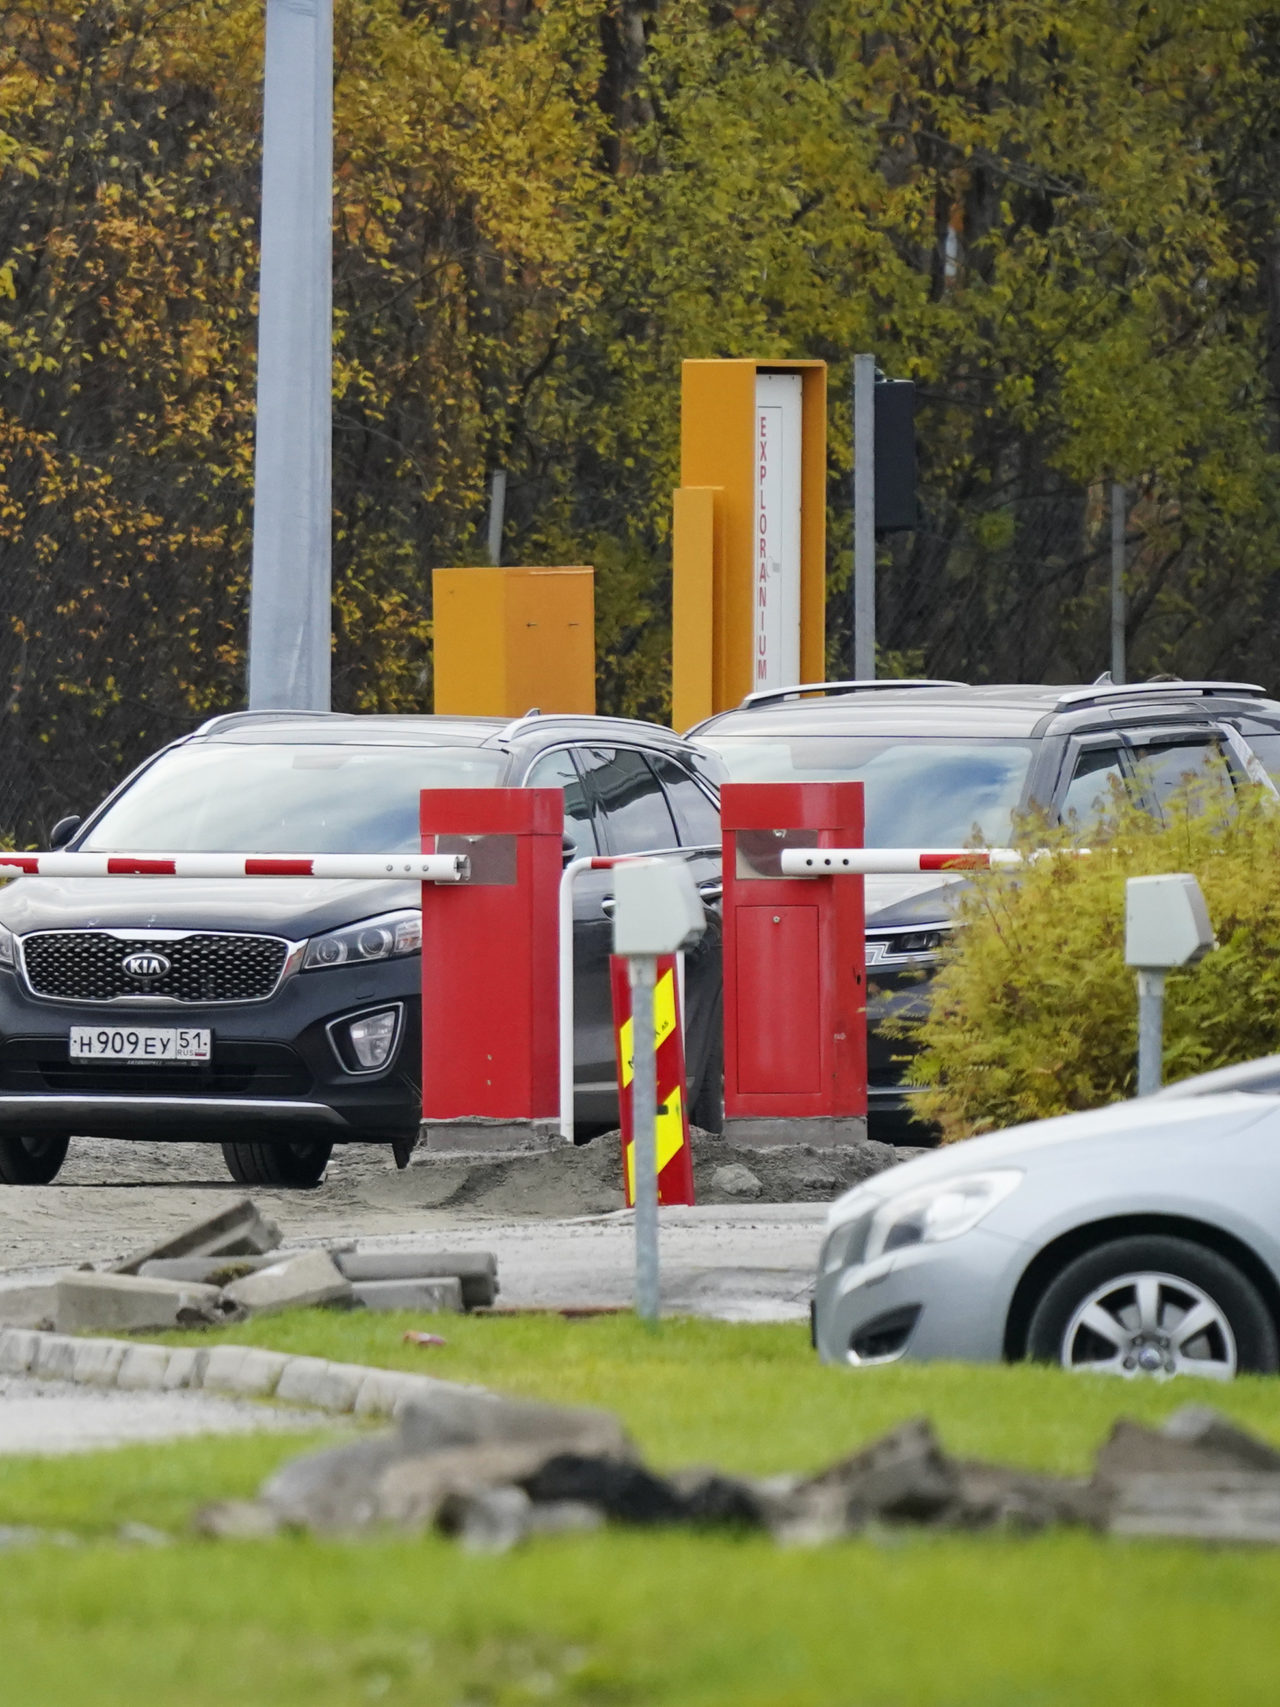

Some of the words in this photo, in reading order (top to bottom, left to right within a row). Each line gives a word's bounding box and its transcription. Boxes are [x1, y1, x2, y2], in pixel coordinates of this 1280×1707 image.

[758, 416, 767, 680] EXPLORANIUM
[130, 959, 161, 974] KIA
[179, 1032, 201, 1049] 51
